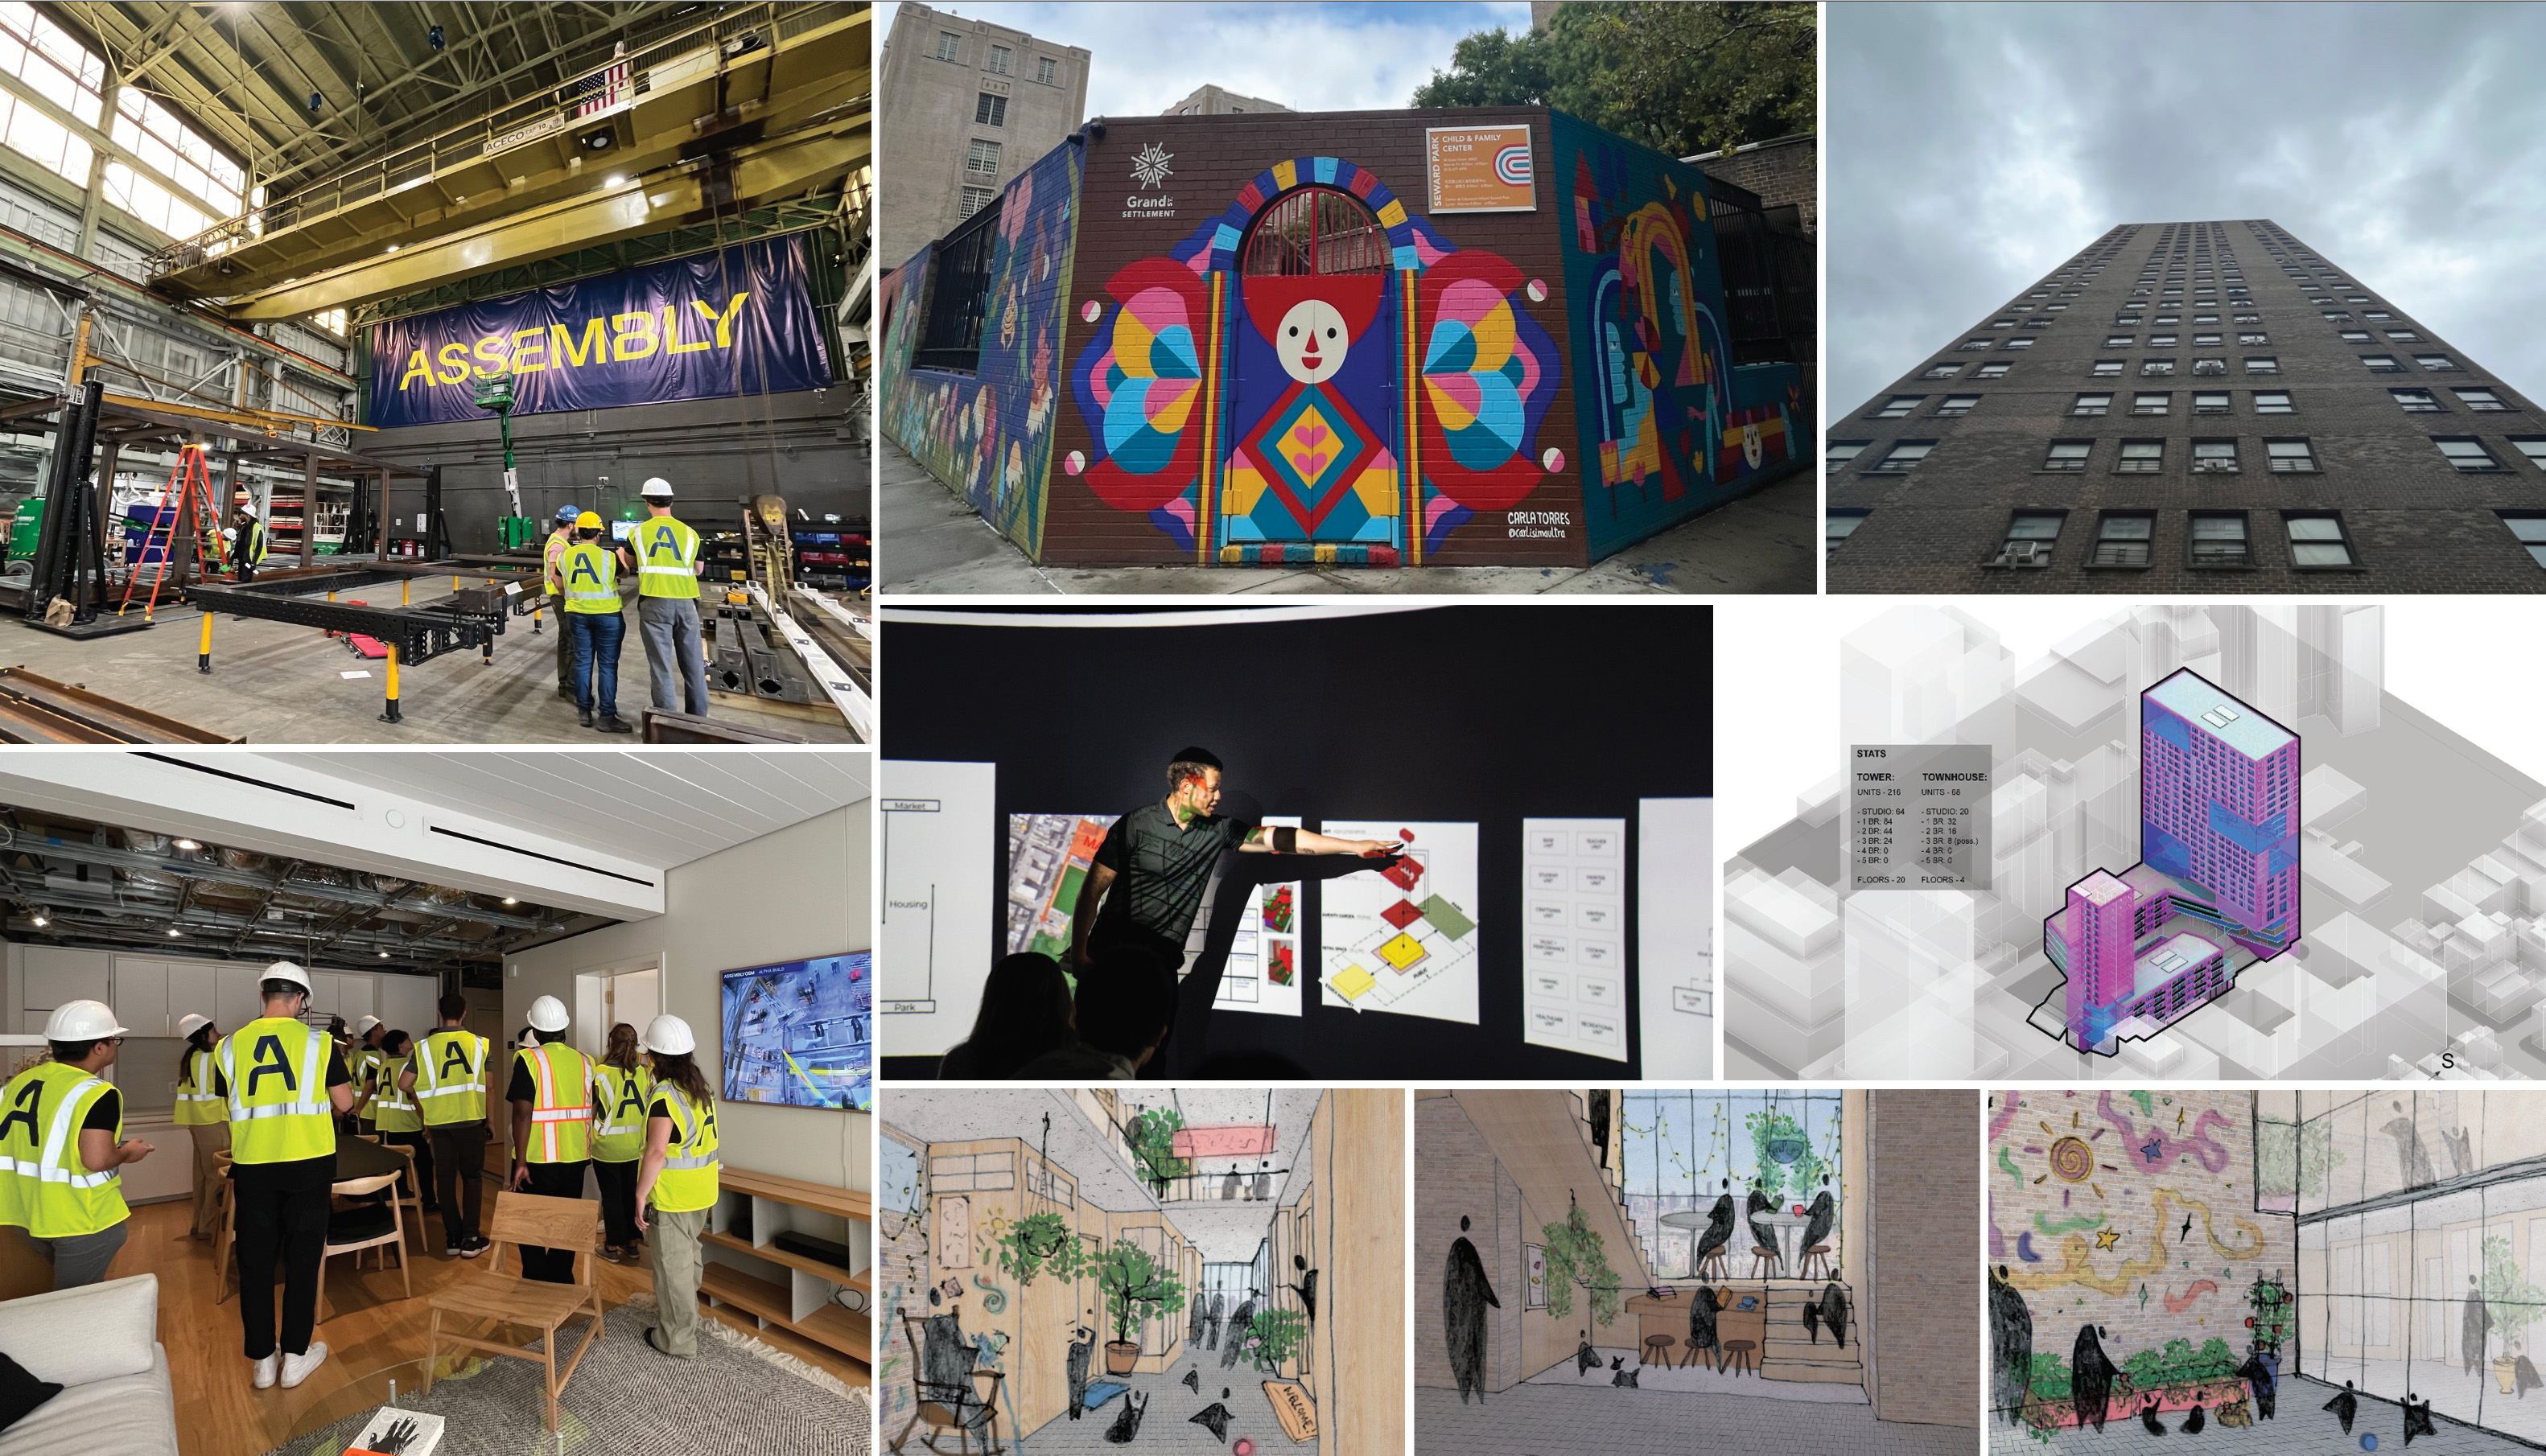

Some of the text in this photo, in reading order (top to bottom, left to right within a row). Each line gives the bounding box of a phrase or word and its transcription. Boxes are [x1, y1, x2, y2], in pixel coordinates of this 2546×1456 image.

[485, 131, 524, 151] ACECO
[1442, 135, 1465, 143] CHILD
[1474, 134, 1502, 142] FAMILY
[1432, 136, 1441, 207] SEWARD PARK
[1127, 195, 1167, 208] Grand
[1122, 210, 1176, 218] SETTLEMENT
[399, 291, 749, 391] ASSEMBLY
[1507, 511, 1571, 524] CARLA TORRES
[649, 525, 682, 561] A
[571, 553, 600, 584] A
[1856, 750, 1887, 758] STATS
[1857, 773, 1895, 781] TOWER:
[1922, 773, 1988, 781] TOWNHOUSE:
[894, 802, 926, 810] Market
[889, 900, 928, 910] Housing
[894, 1003, 916, 1011] Park
[248, 1034, 296, 1096] A
[441, 1041, 474, 1080] A
[2441, 1052, 2454, 1069] S
[379, 1067, 394, 1096] A
[616, 1080, 645, 1118] A
[0, 1079, 45, 1146] A
